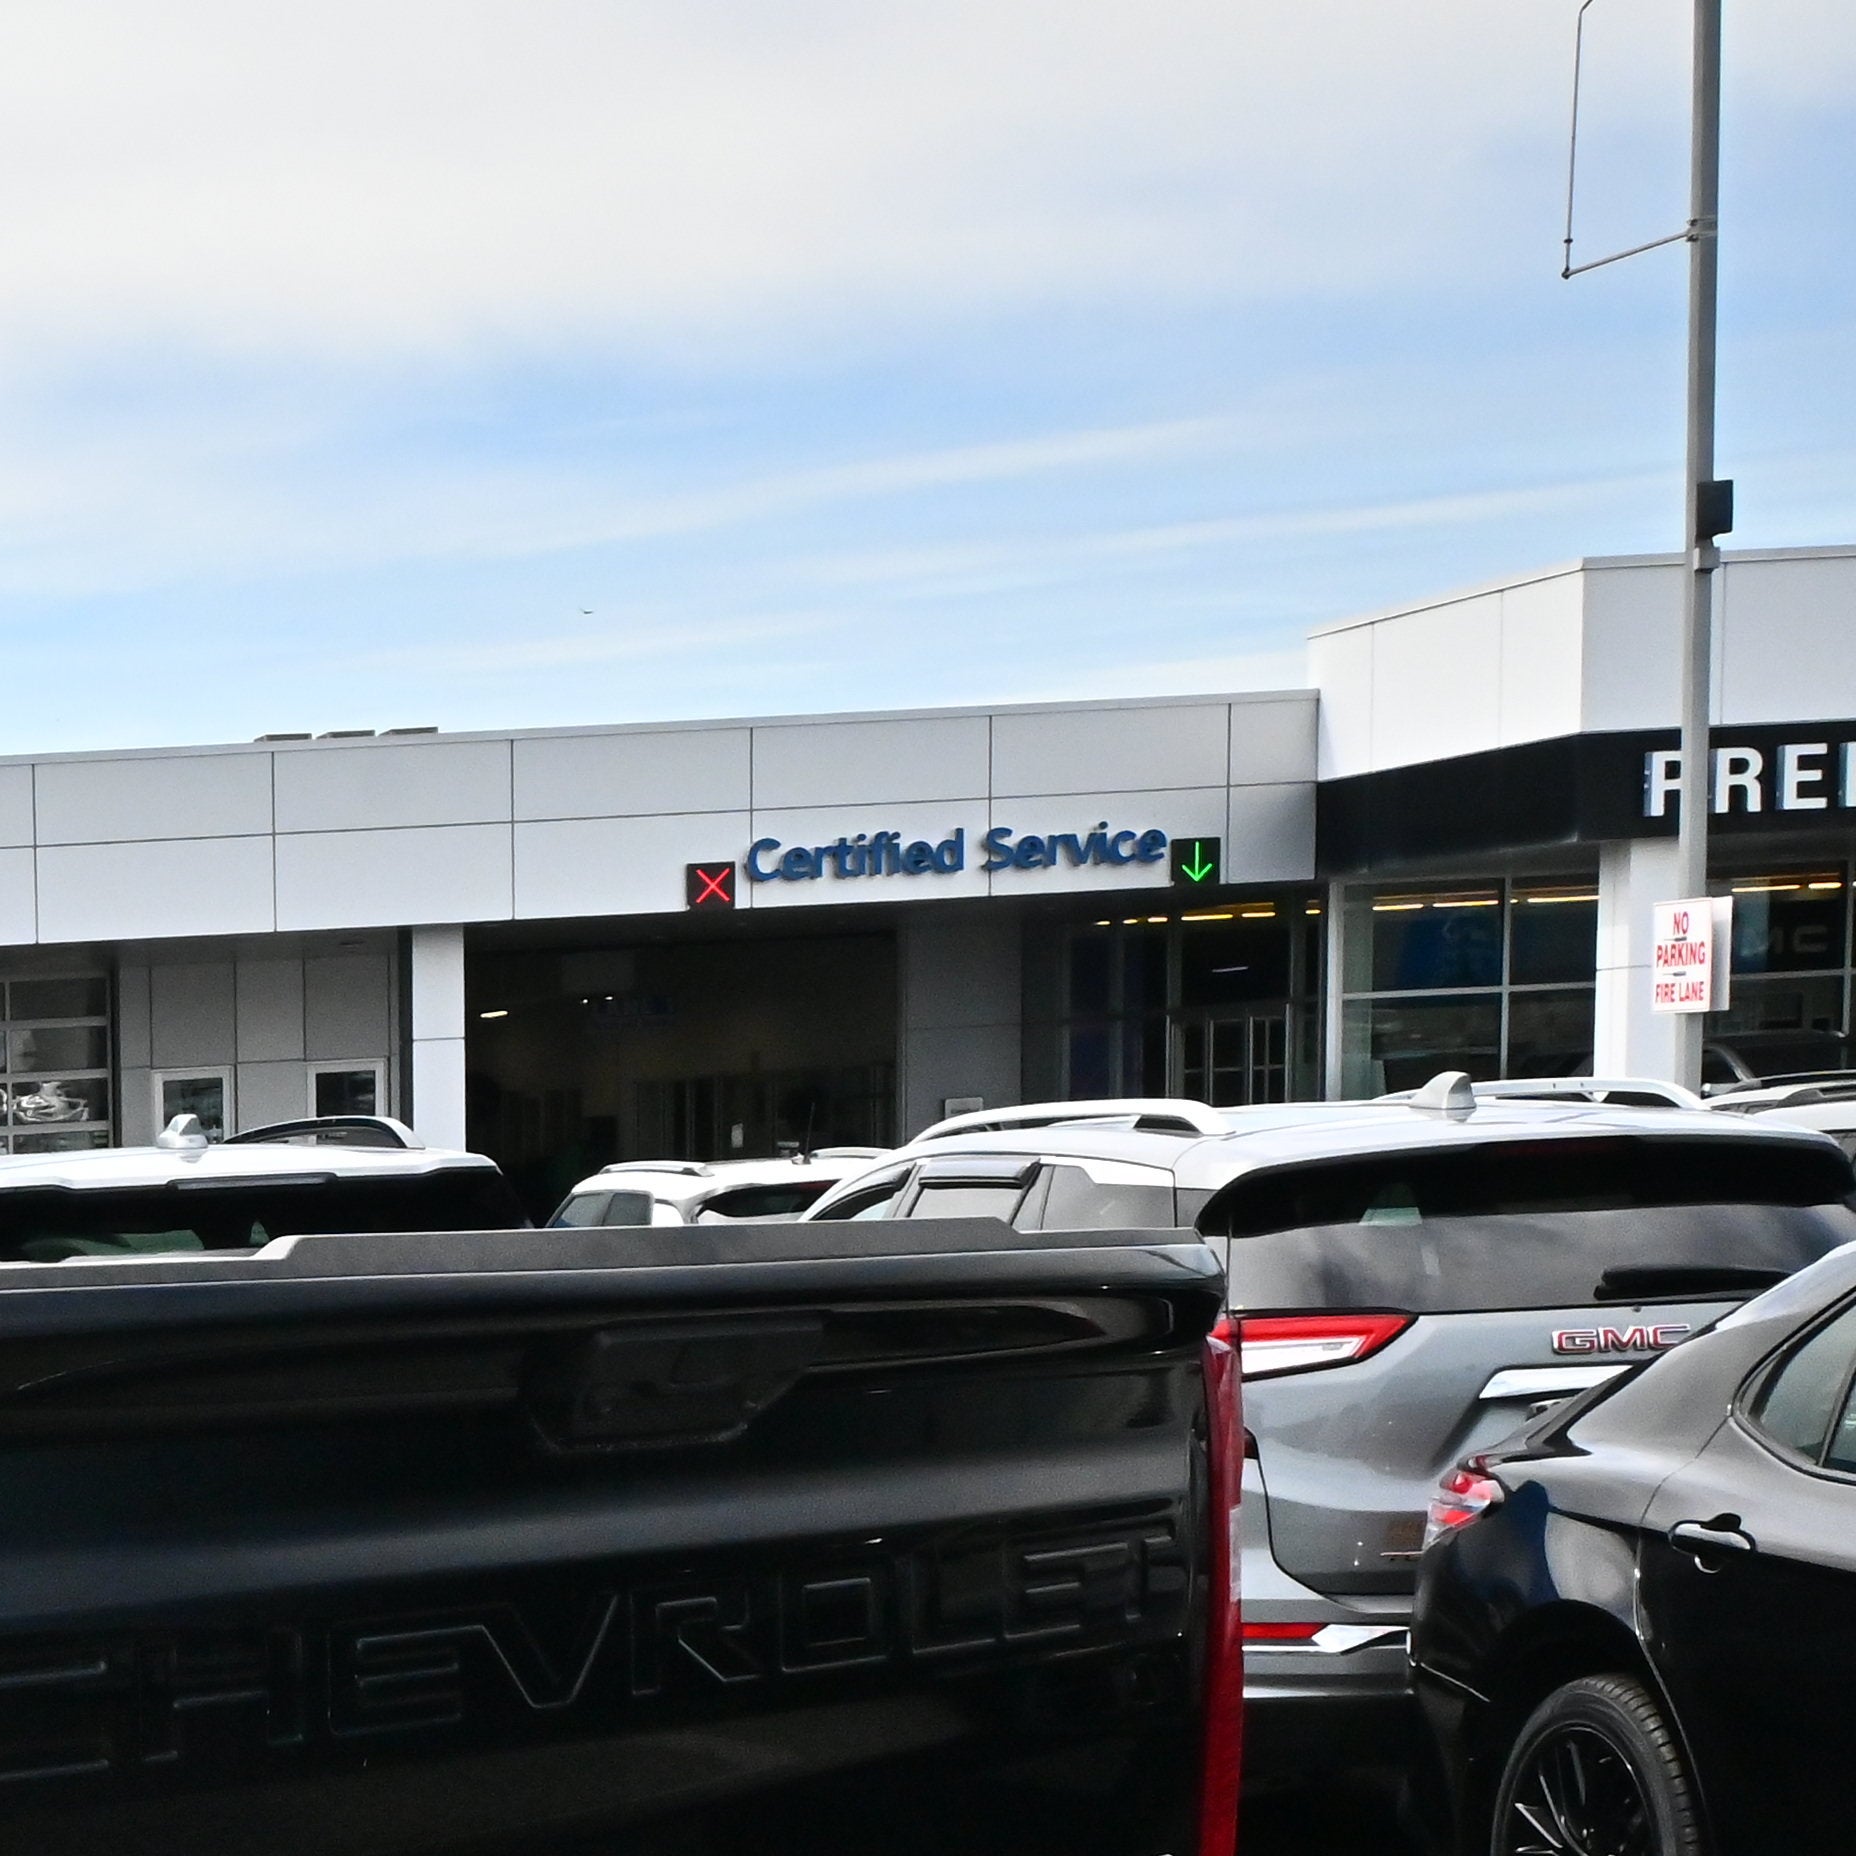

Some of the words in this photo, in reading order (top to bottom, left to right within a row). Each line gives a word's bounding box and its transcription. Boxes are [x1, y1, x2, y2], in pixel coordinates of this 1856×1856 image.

[1644, 741, 1856, 818] PRE
[745, 826, 966, 884] Certified
[982, 820, 1170, 874] Service
[1673, 911, 1689, 935] NO
[1656, 940, 1706, 968] PARKING
[1655, 983, 1676, 1003] FIRE
[1679, 981, 1704, 1002] LANE
[1552, 1323, 1690, 1355] GMC
